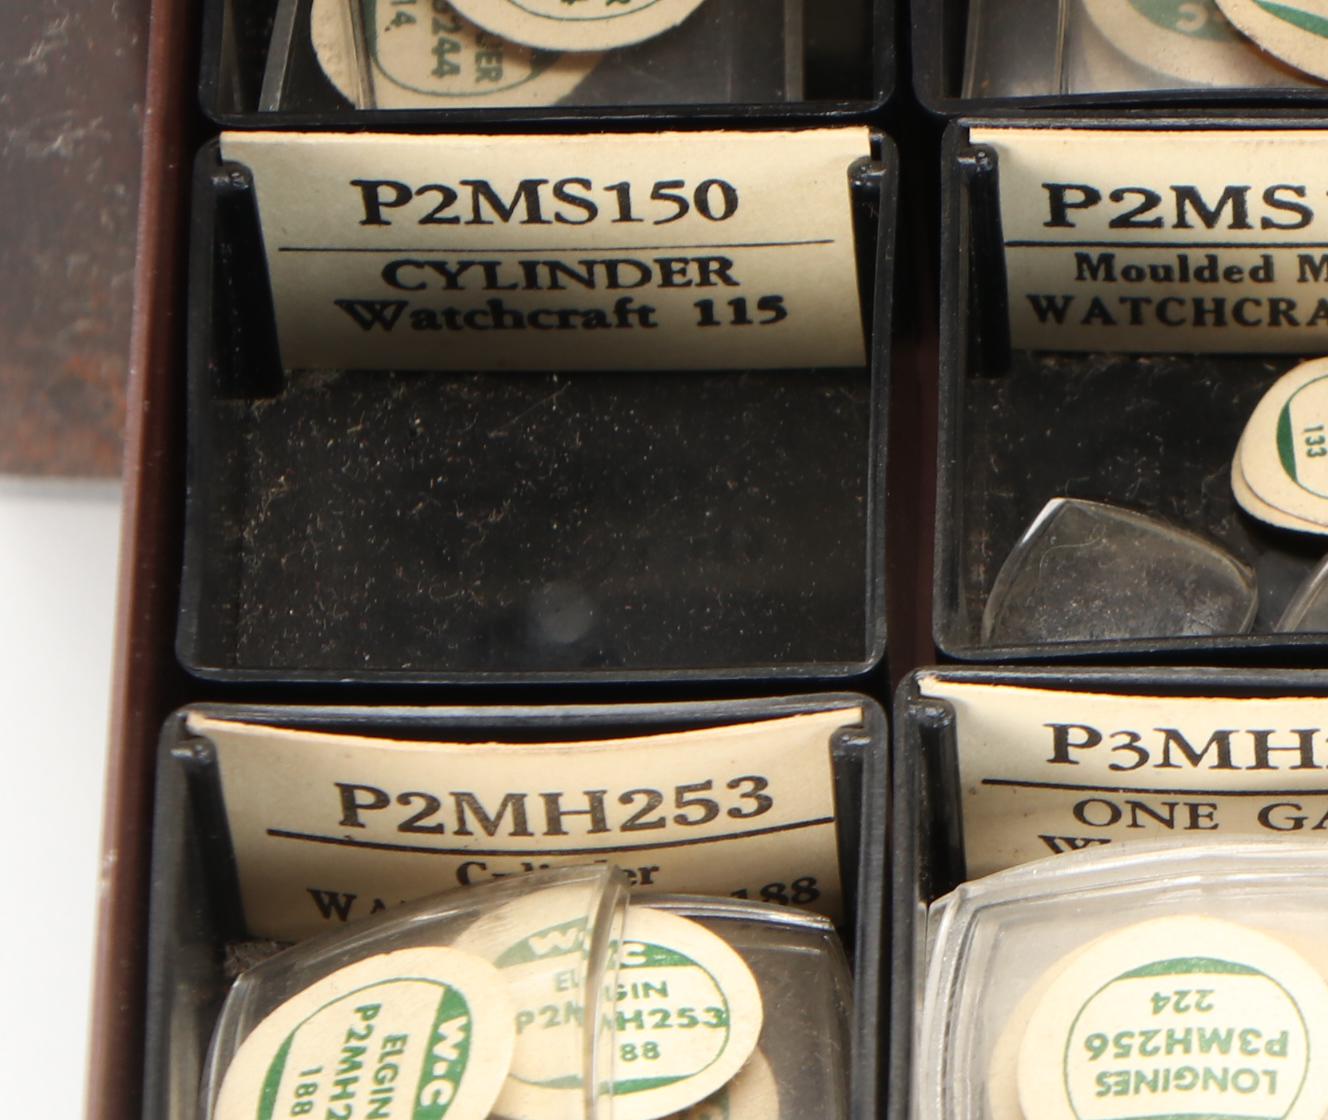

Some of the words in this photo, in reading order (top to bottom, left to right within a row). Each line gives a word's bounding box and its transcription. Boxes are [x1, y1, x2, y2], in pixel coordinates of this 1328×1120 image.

[351, 178, 738, 226] P2MS150
[381, 257, 740, 291] CYLINDER
[1074, 252, 1274, 284] Moulded
[335, 298, 659, 332] Watchcraft
[693, 296, 788, 328] 115
[1304, 424, 1327, 459] 133
[334, 776, 773, 839] P2MH253
[1072, 798, 1219, 831] ONE
[1150, 989, 1214, 1014] 224
[620, 1041, 661, 1061] 88
[1084, 1027, 1289, 1060] P3MH256
[290, 1066, 323, 1117] 188
[366, 1034, 408, 1120] ELGIN
[1094, 1066, 1278, 1097] LONGINES
